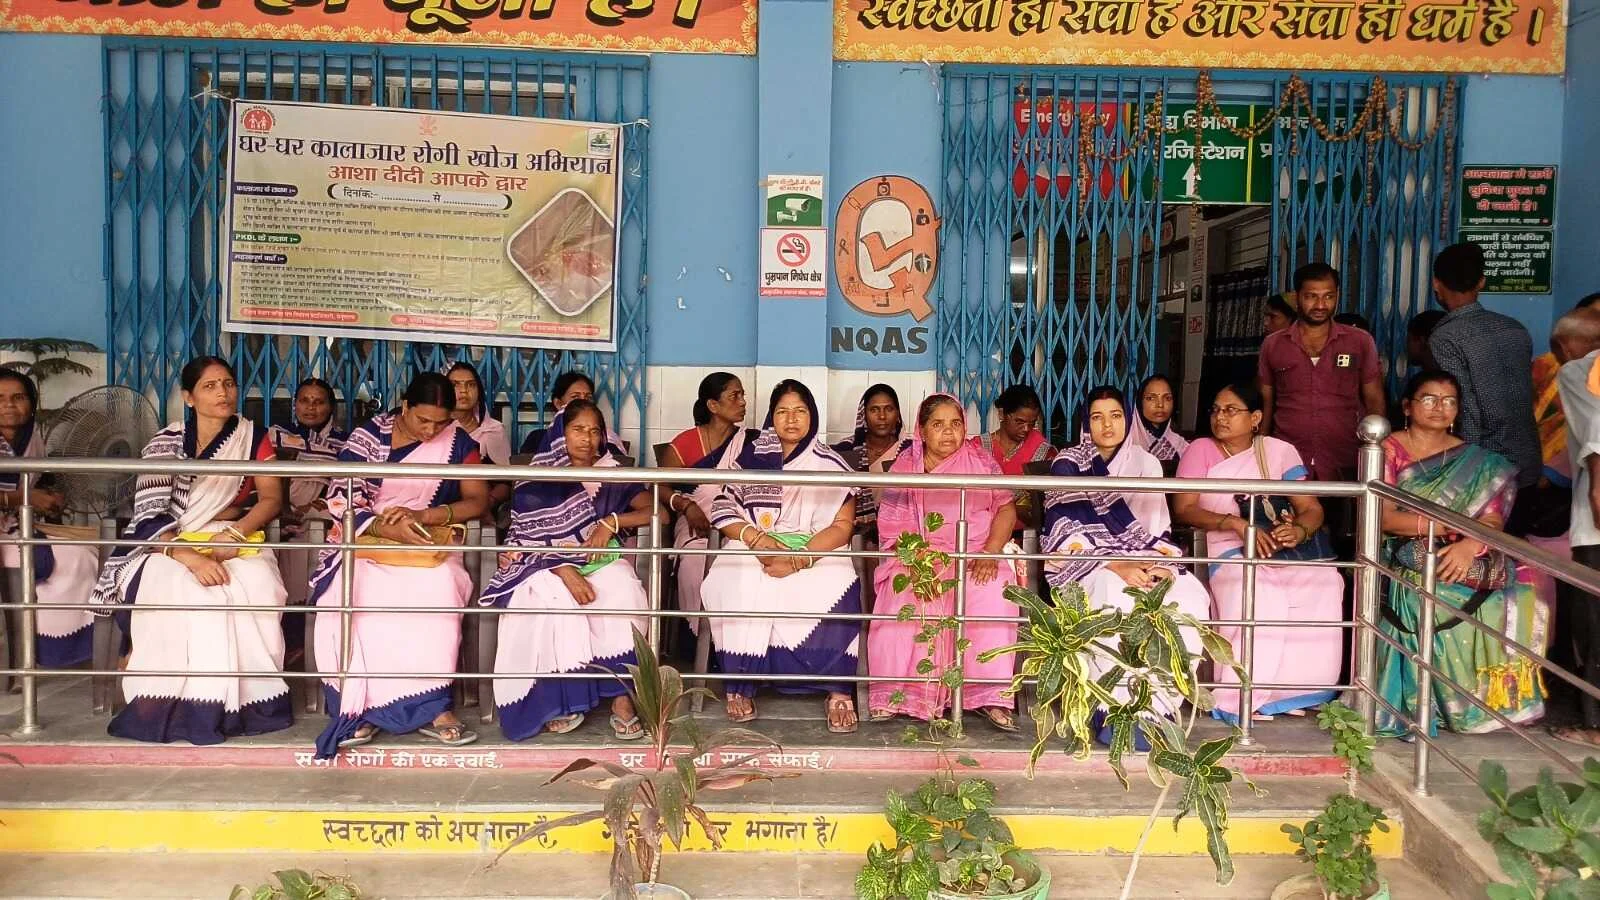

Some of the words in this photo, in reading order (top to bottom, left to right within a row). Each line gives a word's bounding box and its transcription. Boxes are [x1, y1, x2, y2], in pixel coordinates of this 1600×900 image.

[1060, 0, 1143, 34] सवा
[1271, 0, 1353, 39] सवा
[1020, 108, 1111, 127] Emergy
[239, 135, 304, 156] घर-घर
[310, 139, 406, 163] कालाजार
[413, 139, 461, 166] रोगी
[467, 144, 519, 170] खोज
[526, 149, 612, 174] अभियान
[328, 164, 378, 182] आशा
[383, 164, 424, 184] दीदी
[431, 170, 490, 188] आपके
[495, 175, 528, 191] द्वार
[831, 326, 929, 356] NQAS
[346, 748, 386, 768] रोगों
[391, 750, 417, 768] की
[420, 753, 448, 768] एक
[619, 752, 647, 768] घर
[323, 818, 410, 846] स्वच्छता
[415, 814, 443, 843] को
[746, 819, 808, 841] भगाना
